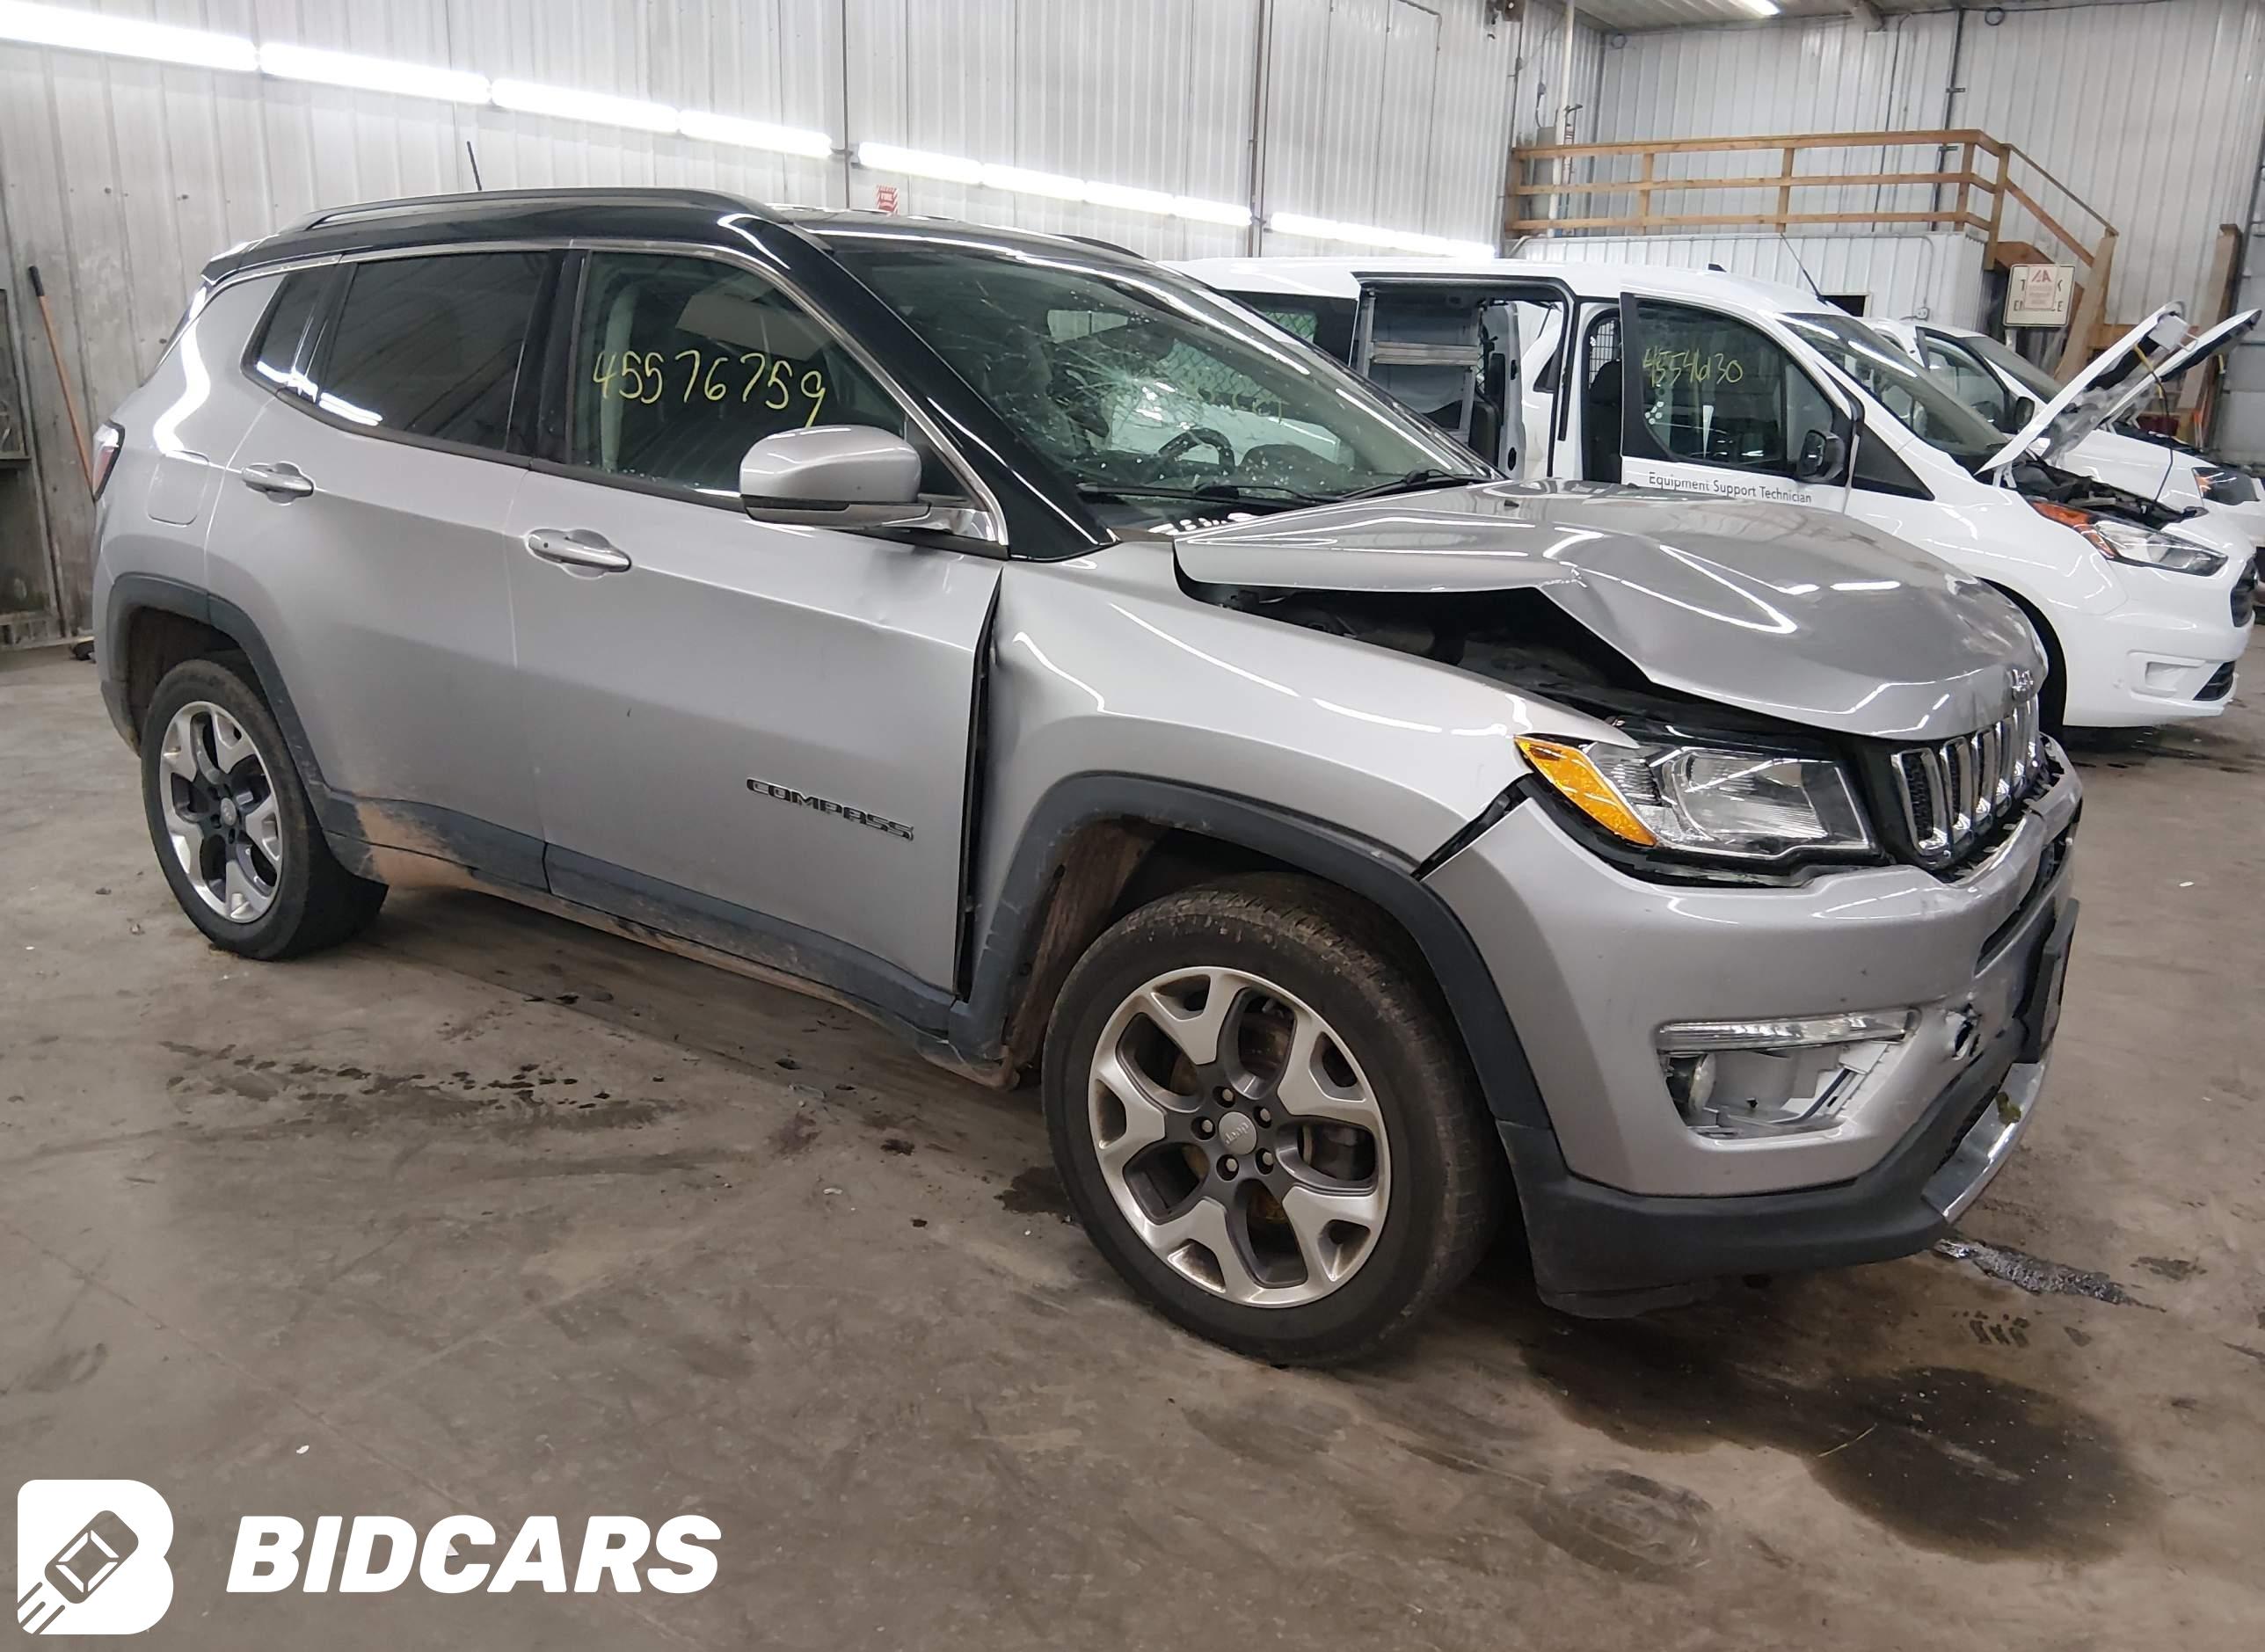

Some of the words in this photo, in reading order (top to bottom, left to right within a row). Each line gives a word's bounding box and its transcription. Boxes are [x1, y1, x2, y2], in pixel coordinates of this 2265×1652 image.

[593, 350, 826, 428] 45576759
[1649, 471, 1709, 491] Equipment
[1714, 480, 1756, 498] Support
[1759, 485, 1811, 503] Technician
[747, 777, 914, 841] COMPASS
[1225, 1122, 1249, 1145] Jeep
